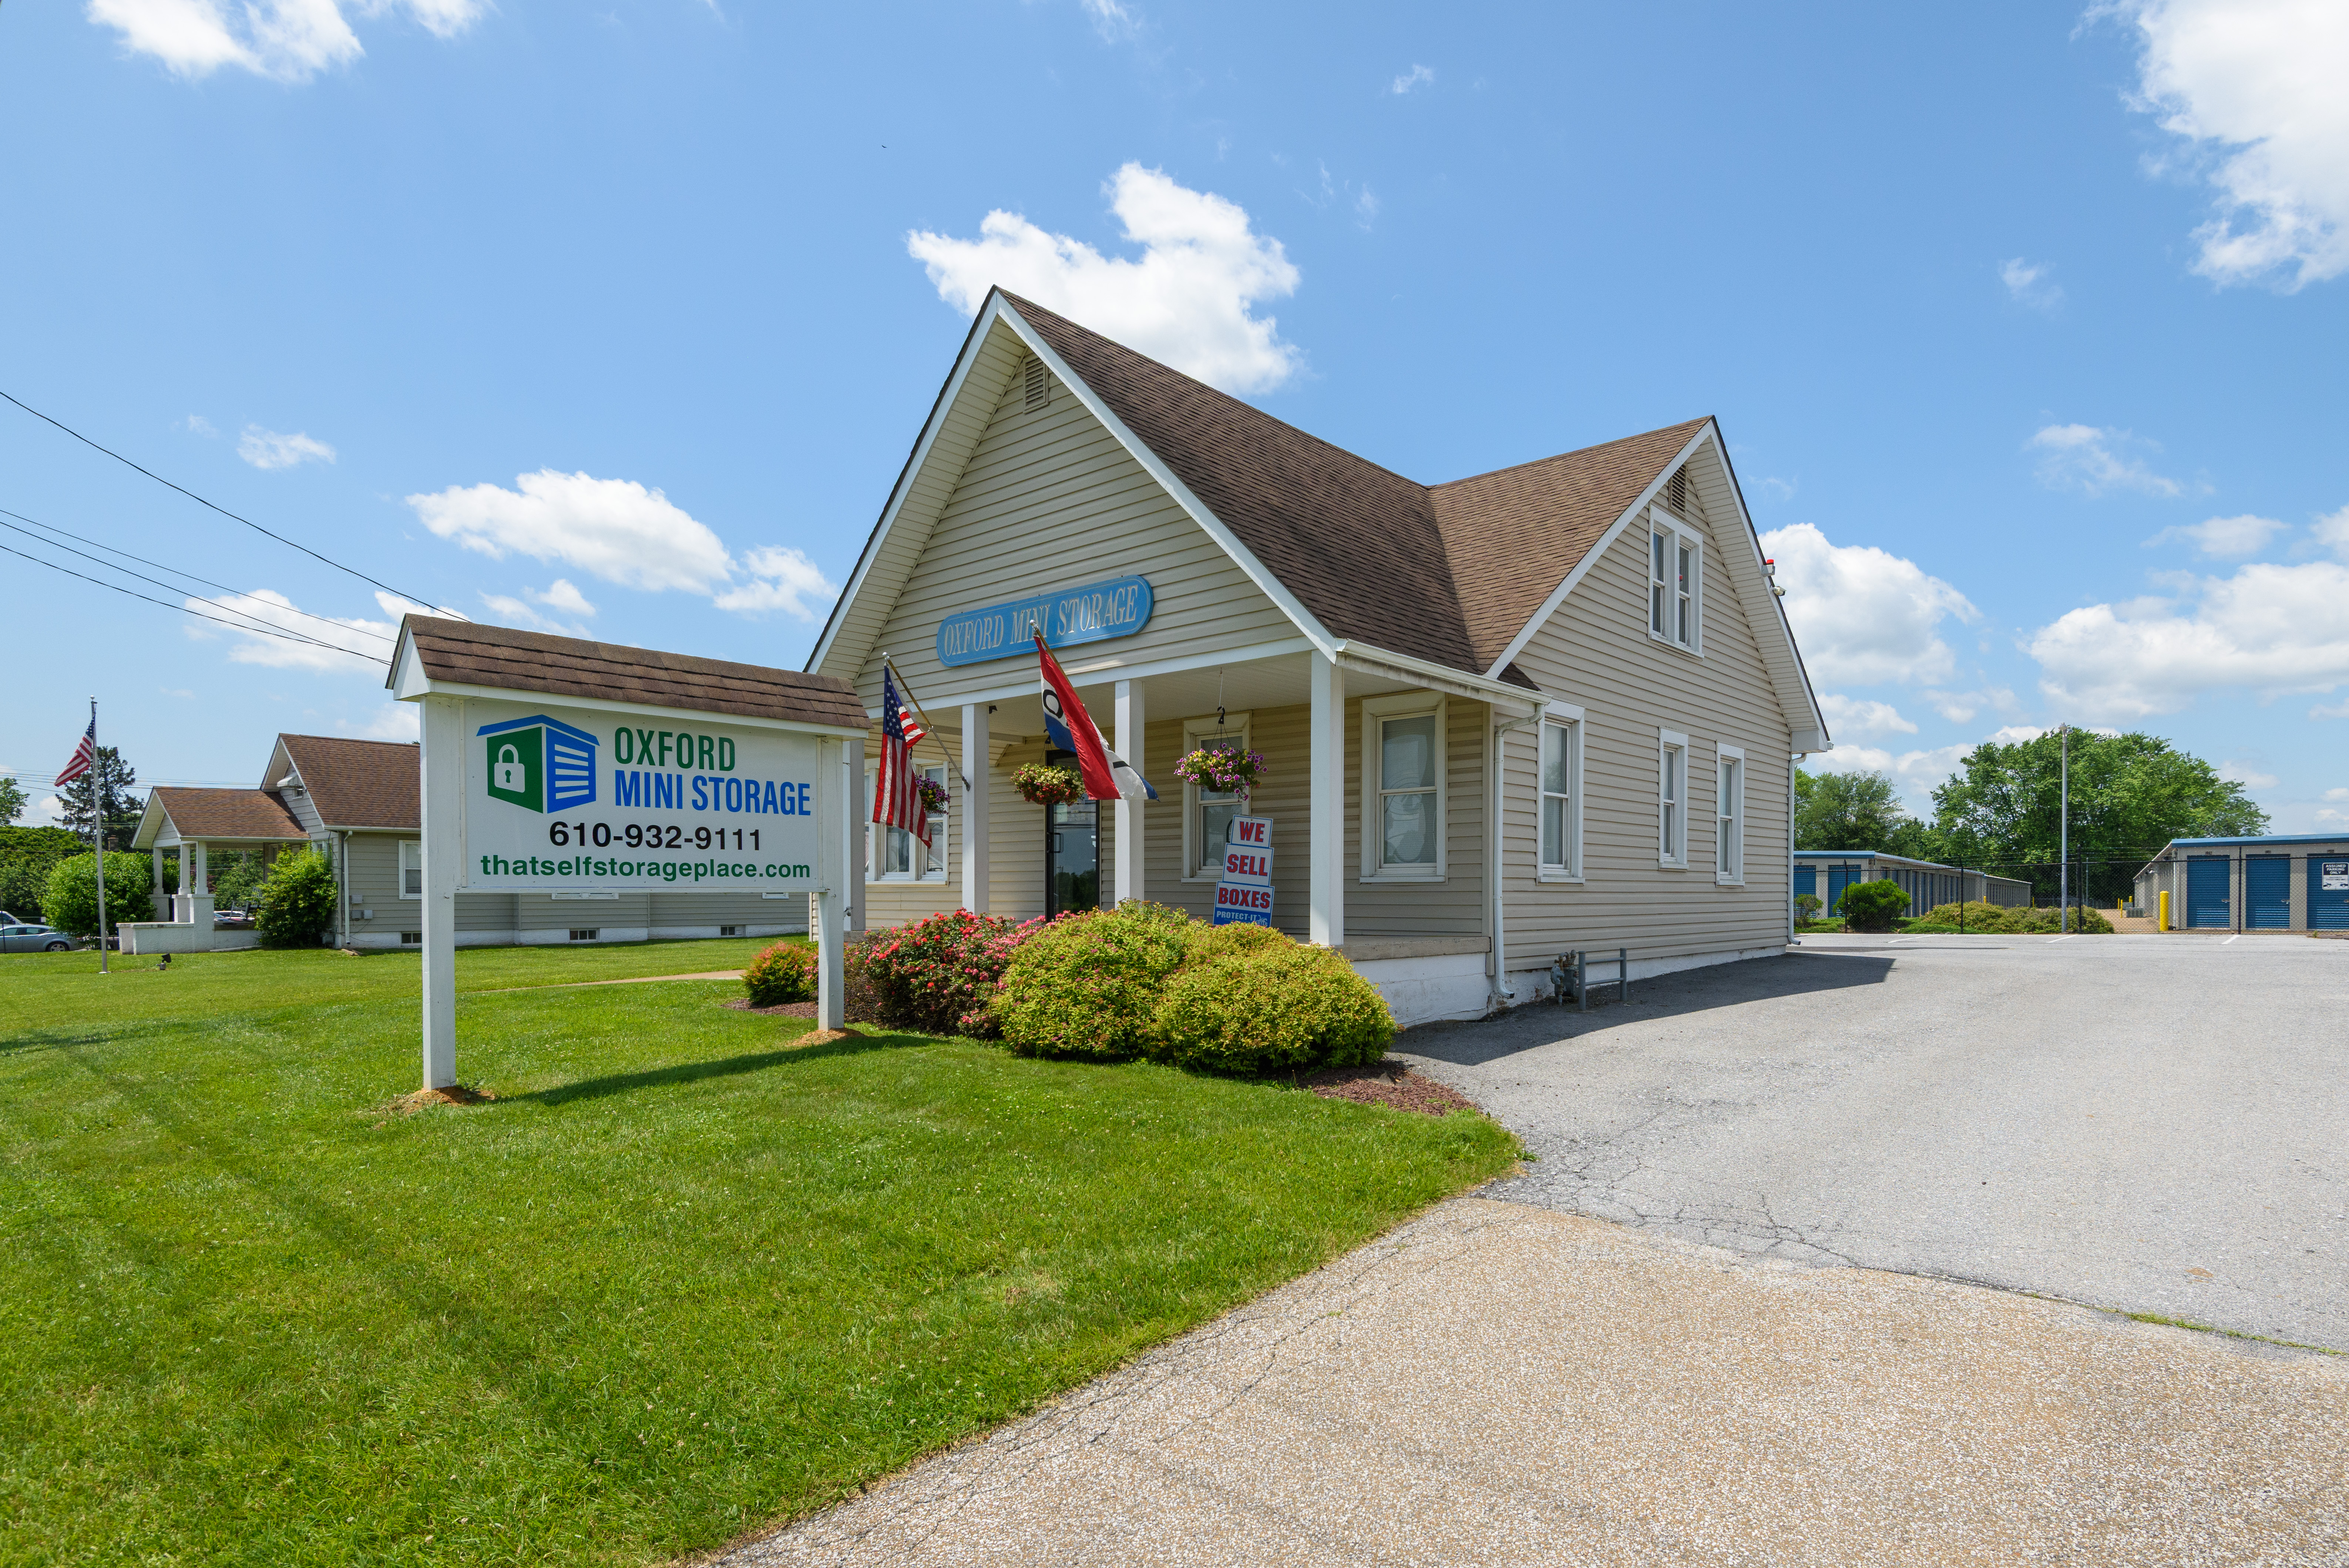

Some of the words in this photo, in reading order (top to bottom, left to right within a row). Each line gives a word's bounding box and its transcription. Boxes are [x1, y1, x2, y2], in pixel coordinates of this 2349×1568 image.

[944, 615, 1004, 657] OXFORD
[1009, 604, 1051, 644] MINI
[1057, 585, 1138, 636] STORAGE
[615, 727, 735, 771] OXFORD
[615, 770, 683, 809] MINI
[691, 775, 811, 816] STORAGE
[549, 821, 760, 850] 610-932-9111
[1240, 821, 1265, 842] WE
[480, 854, 810, 882] thatselfstorageplace.com
[1226, 854, 1268, 876] SELL
[1218, 887, 1271, 909] BOXES
[1216, 910, 1257, 921] PROTECT-IT
